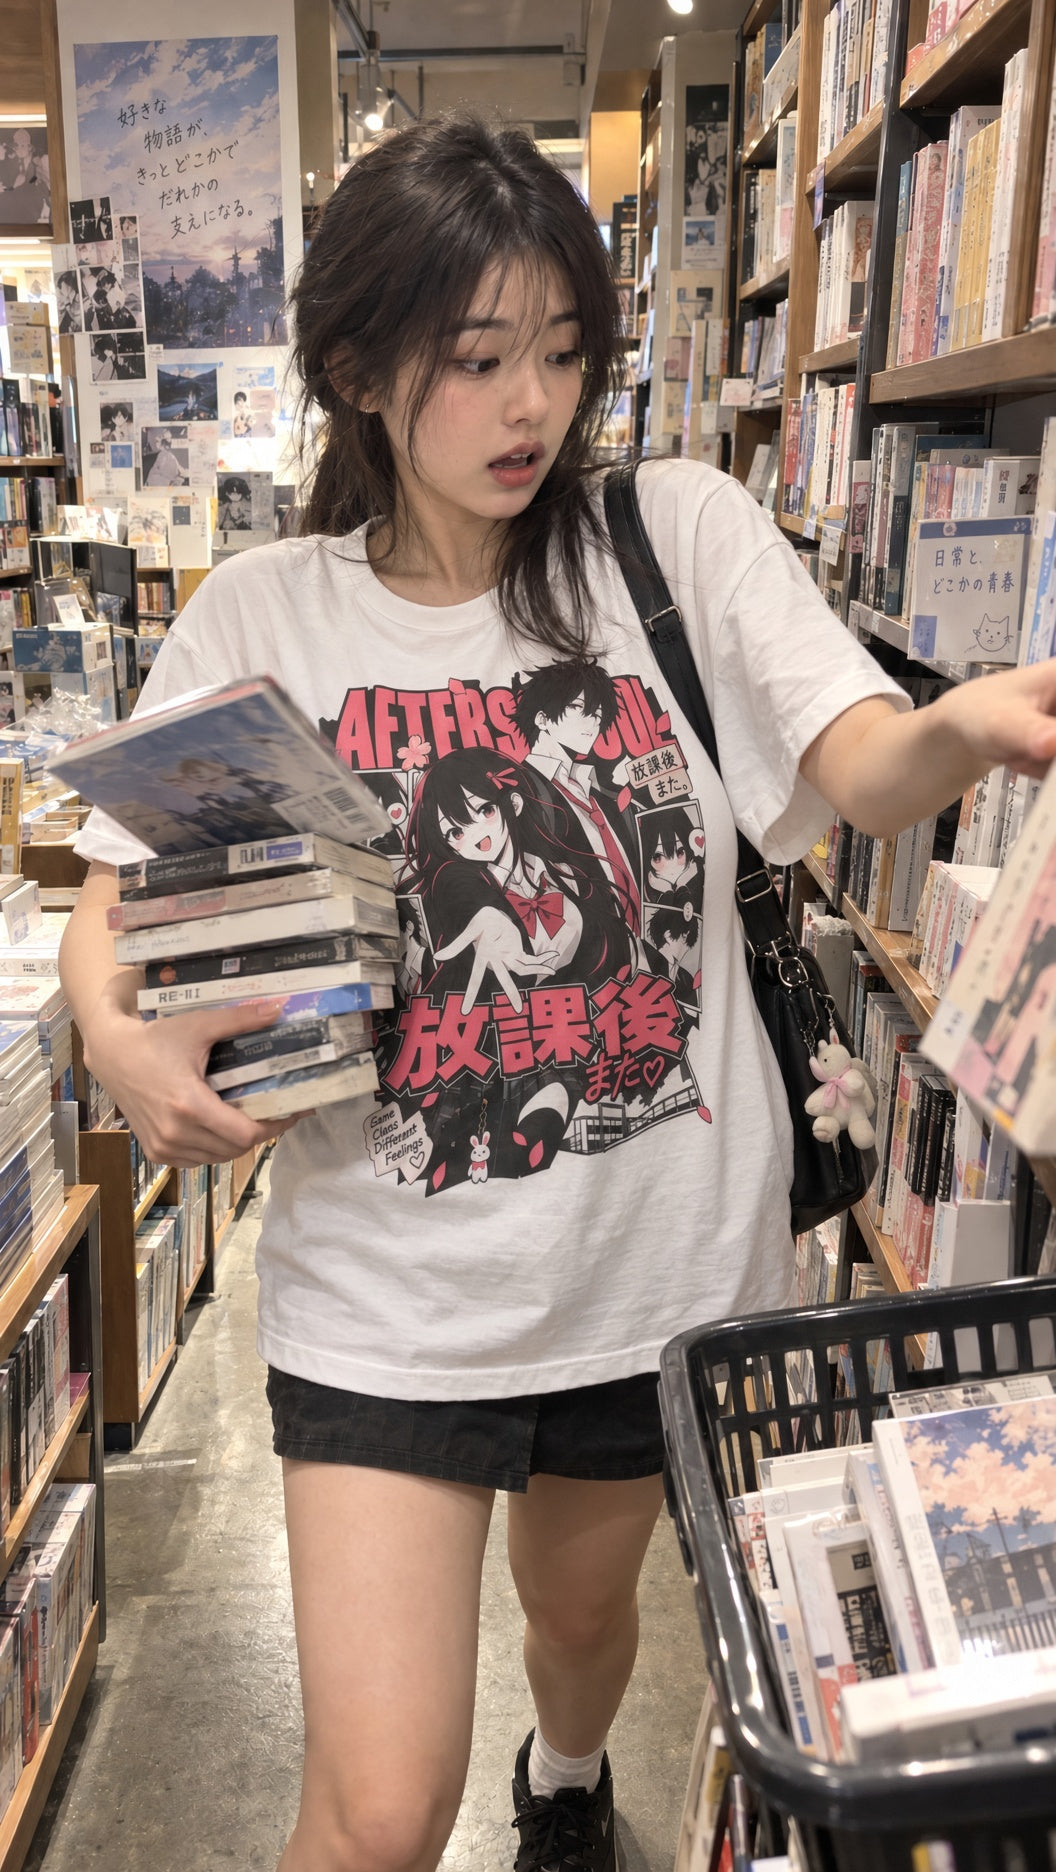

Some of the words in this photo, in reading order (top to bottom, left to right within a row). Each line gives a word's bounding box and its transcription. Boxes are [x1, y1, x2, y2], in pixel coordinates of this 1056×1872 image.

[117, 98, 167, 128] 好きな
[143, 118, 208, 153] 物語が、
[159, 178, 219, 209] だれかの
[170, 199, 254, 240] 支えになる。
[933, 570, 1015, 594] どこかの青春
[631, 749, 678, 782] 放課後
[655, 775, 688, 798] また。
[384, 976, 685, 1091] 放課後
[385, 1137, 424, 1166] Feelings
